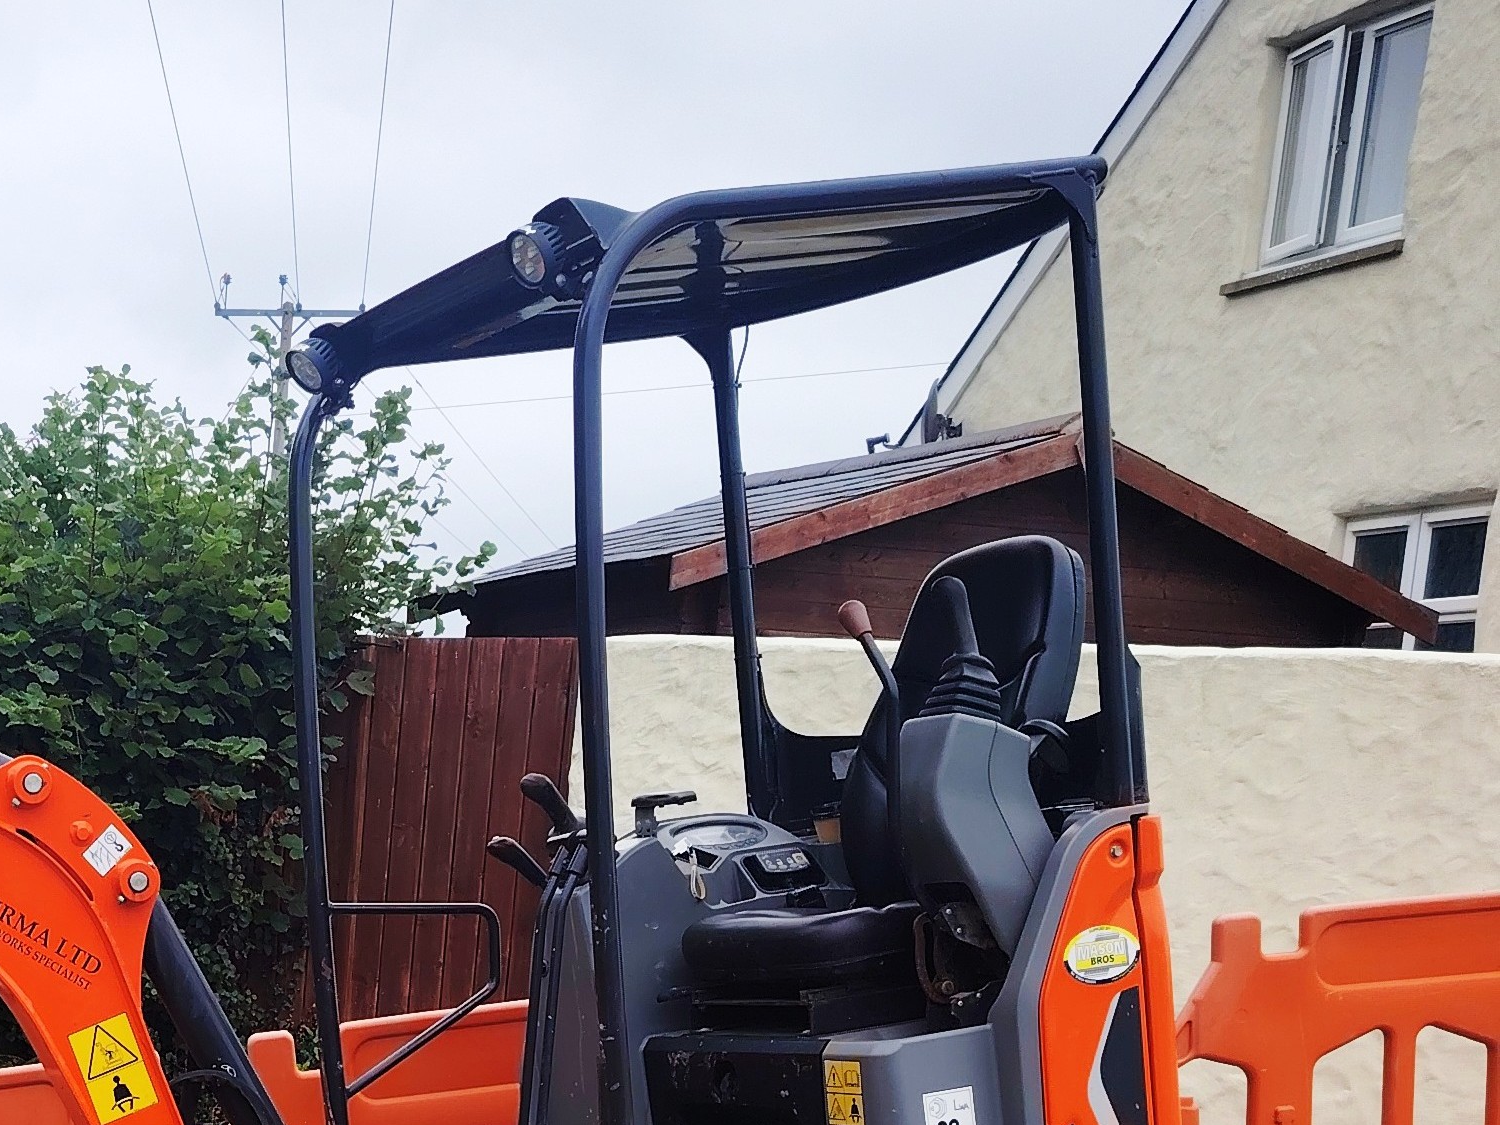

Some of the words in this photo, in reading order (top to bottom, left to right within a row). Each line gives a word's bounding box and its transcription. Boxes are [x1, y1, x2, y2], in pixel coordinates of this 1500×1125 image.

[55, 937, 102, 974] LTD
[1076, 937, 1126, 960] MASON
[1090, 954, 1115, 965] BROS
[33, 951, 92, 990] SPECIALIST
